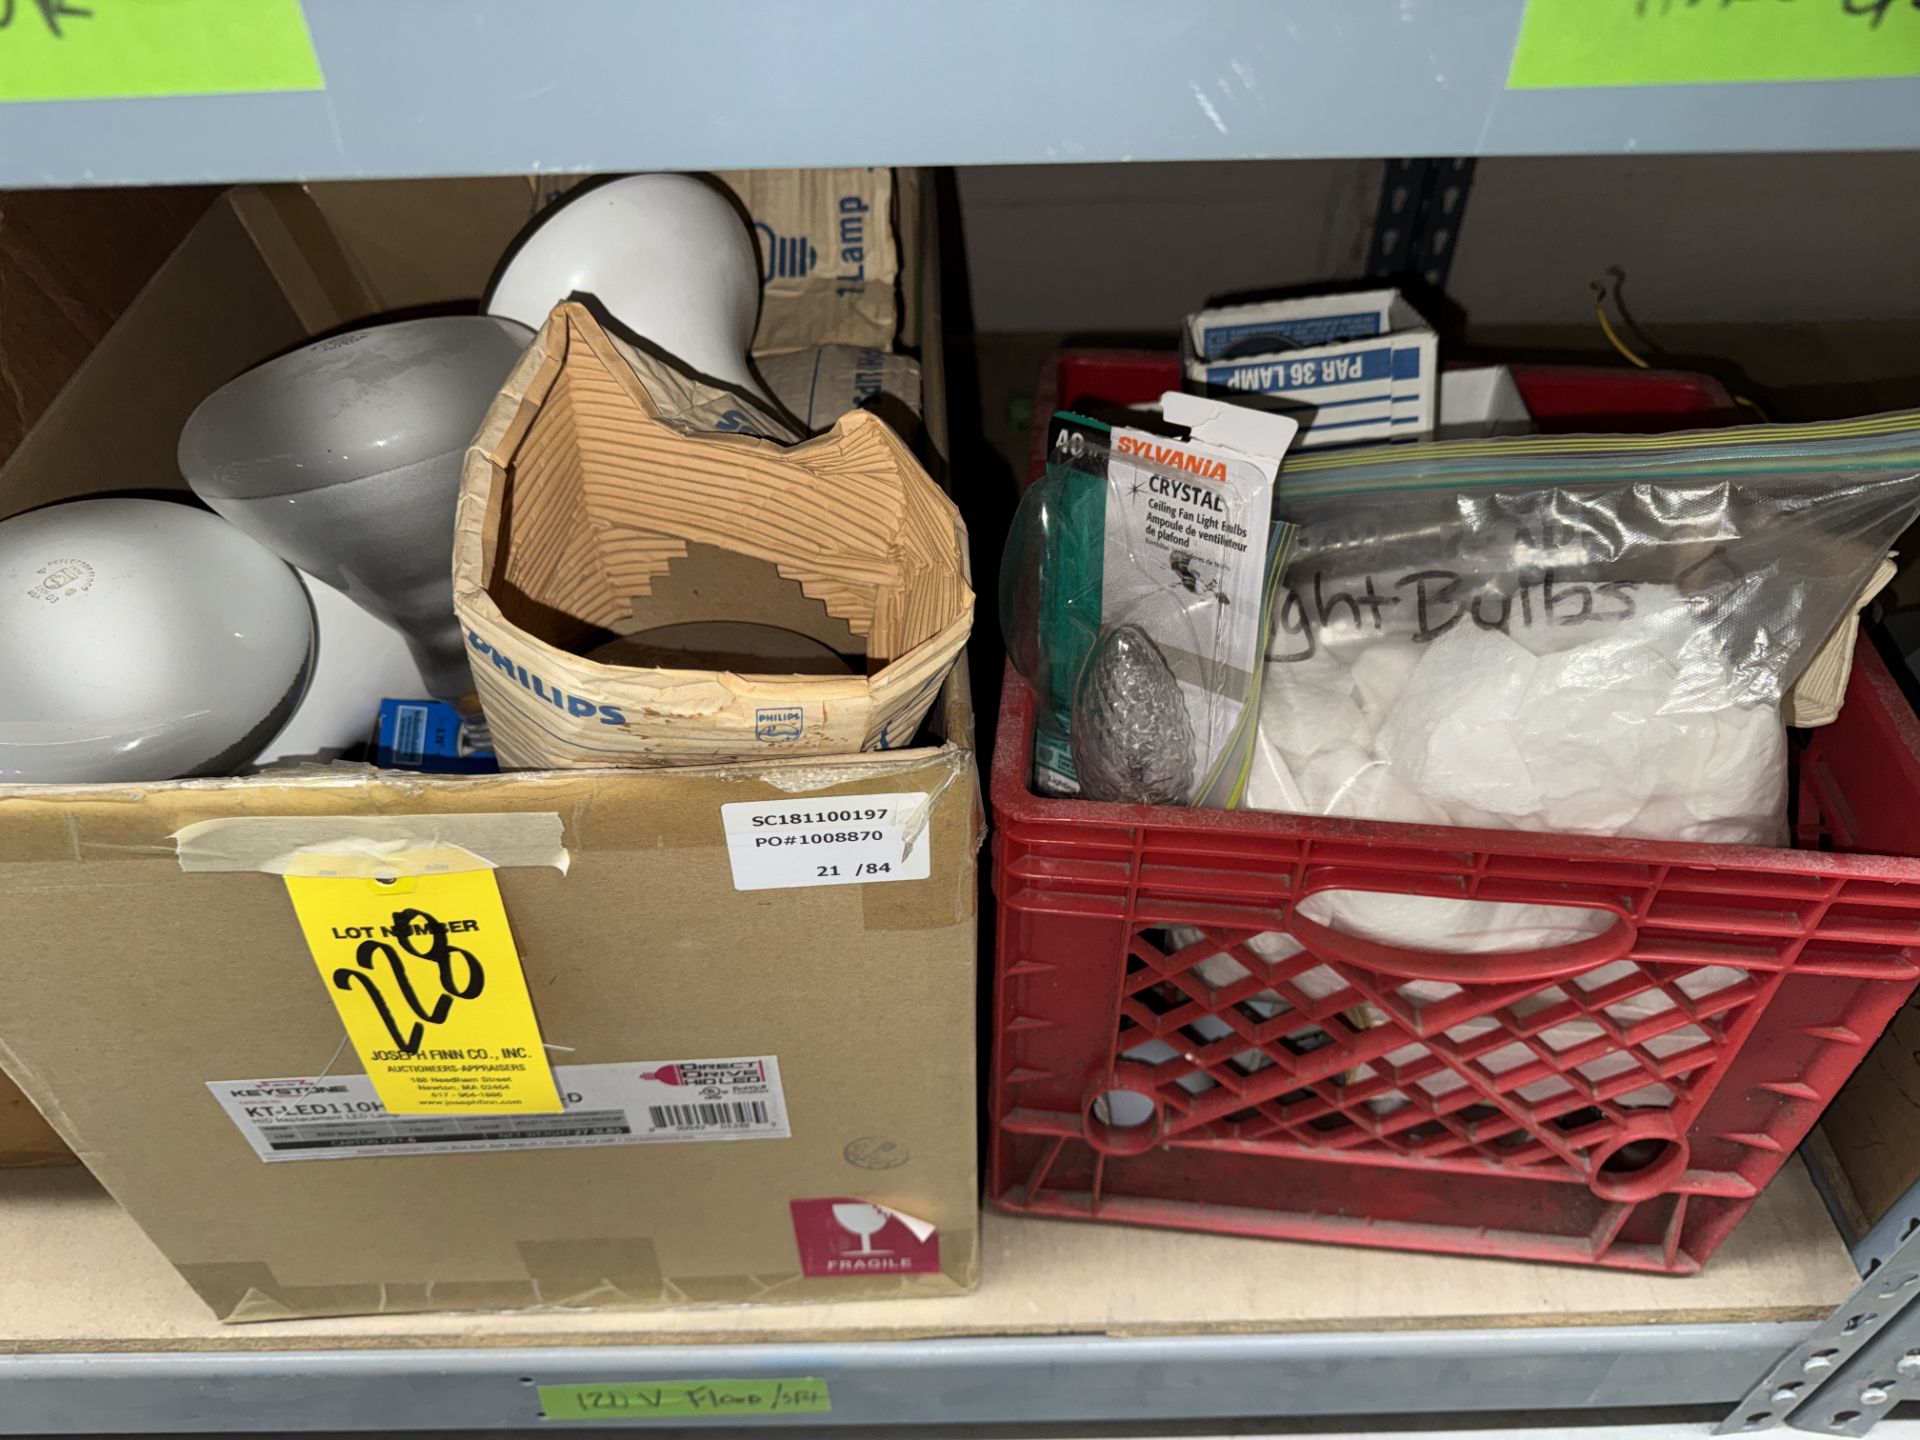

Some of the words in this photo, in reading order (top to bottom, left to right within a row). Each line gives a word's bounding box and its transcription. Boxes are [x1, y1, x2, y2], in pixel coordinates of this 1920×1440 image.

[1227, 364, 1285, 390] LAMP
[1291, 361, 1315, 385] 36
[1321, 354, 1363, 382] PAR
[1055, 428, 1084, 457] 40
[1117, 435, 1228, 481] SYLVANIA
[1149, 475, 1223, 513] CRYSTAL
[1148, 498, 1177, 518] Ceiling
[1178, 508, 1194, 522] Fan
[1196, 513, 1219, 530] Light
[1221, 520, 1247, 538] Bulbs
[1145, 524, 1156, 536] de
[1157, 529, 1190, 548] plafond
[1146, 512, 1184, 533] Ampoule
[1185, 525, 1197, 536] de
[1198, 530, 1248, 552] ventilateur
[1394, 568, 1639, 643] Bulbs
[759, 713, 801, 723] PHILIPS
[752, 809, 888, 827] SC181100197
[755, 830, 883, 847] PO#1008870
[816, 865, 841, 877] 21
[855, 862, 892, 877] /84
[332, 926, 374, 939] LOT
[332, 908, 485, 1055] 228
[371, 1050, 427, 1062] JOSEPH
[431, 1049, 465, 1060] FINN
[503, 1047, 533, 1058] INC.
[680, 1061, 757, 1070] DIRECT
[683, 1070, 759, 1078] DRIVE
[230, 1085, 349, 1098] KEYSTONE
[684, 1078, 717, 1086] HID
[719, 1076, 761, 1084] LED
[827, 1256, 912, 1271] FRAGILE
